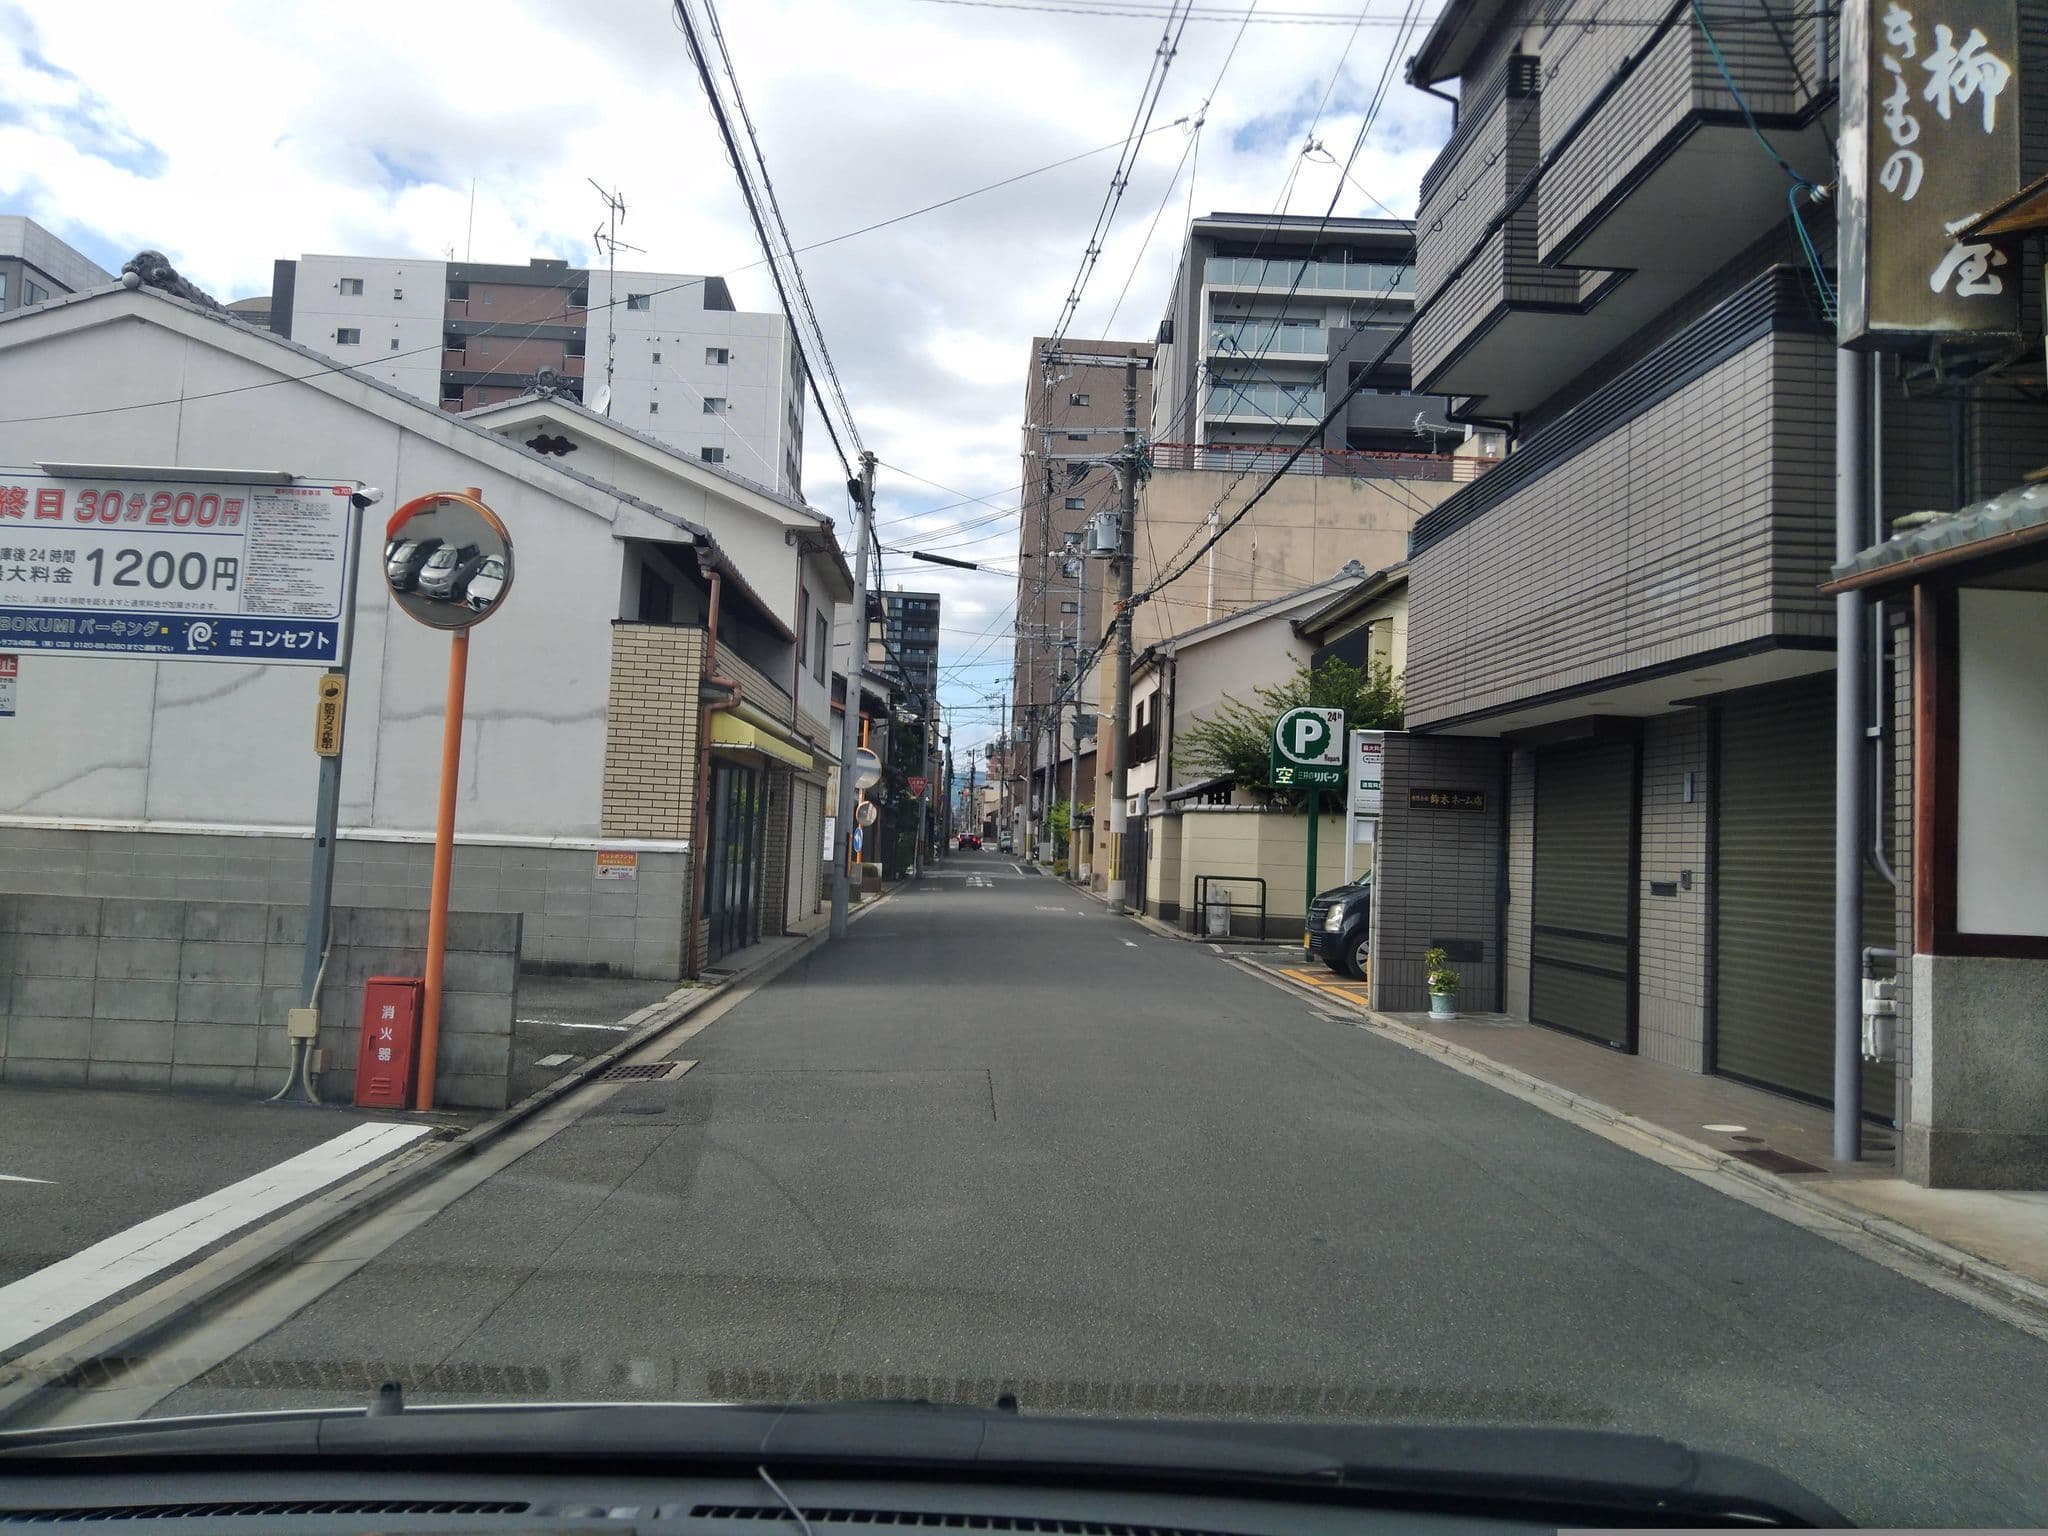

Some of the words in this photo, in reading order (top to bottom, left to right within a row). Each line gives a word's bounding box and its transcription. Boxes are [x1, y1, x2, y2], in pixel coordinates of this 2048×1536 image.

[74, 488, 245, 528] 30分200円
[0, 565, 73, 584] 大料金
[86, 547, 239, 592] 1200円
[79, 618, 160, 638] パーキング
[249, 630, 330, 650] コンセプト
[1295, 718, 1323, 754] P
[1275, 766, 1294, 784] 空
[377, 1005, 396, 1062] 消火器
